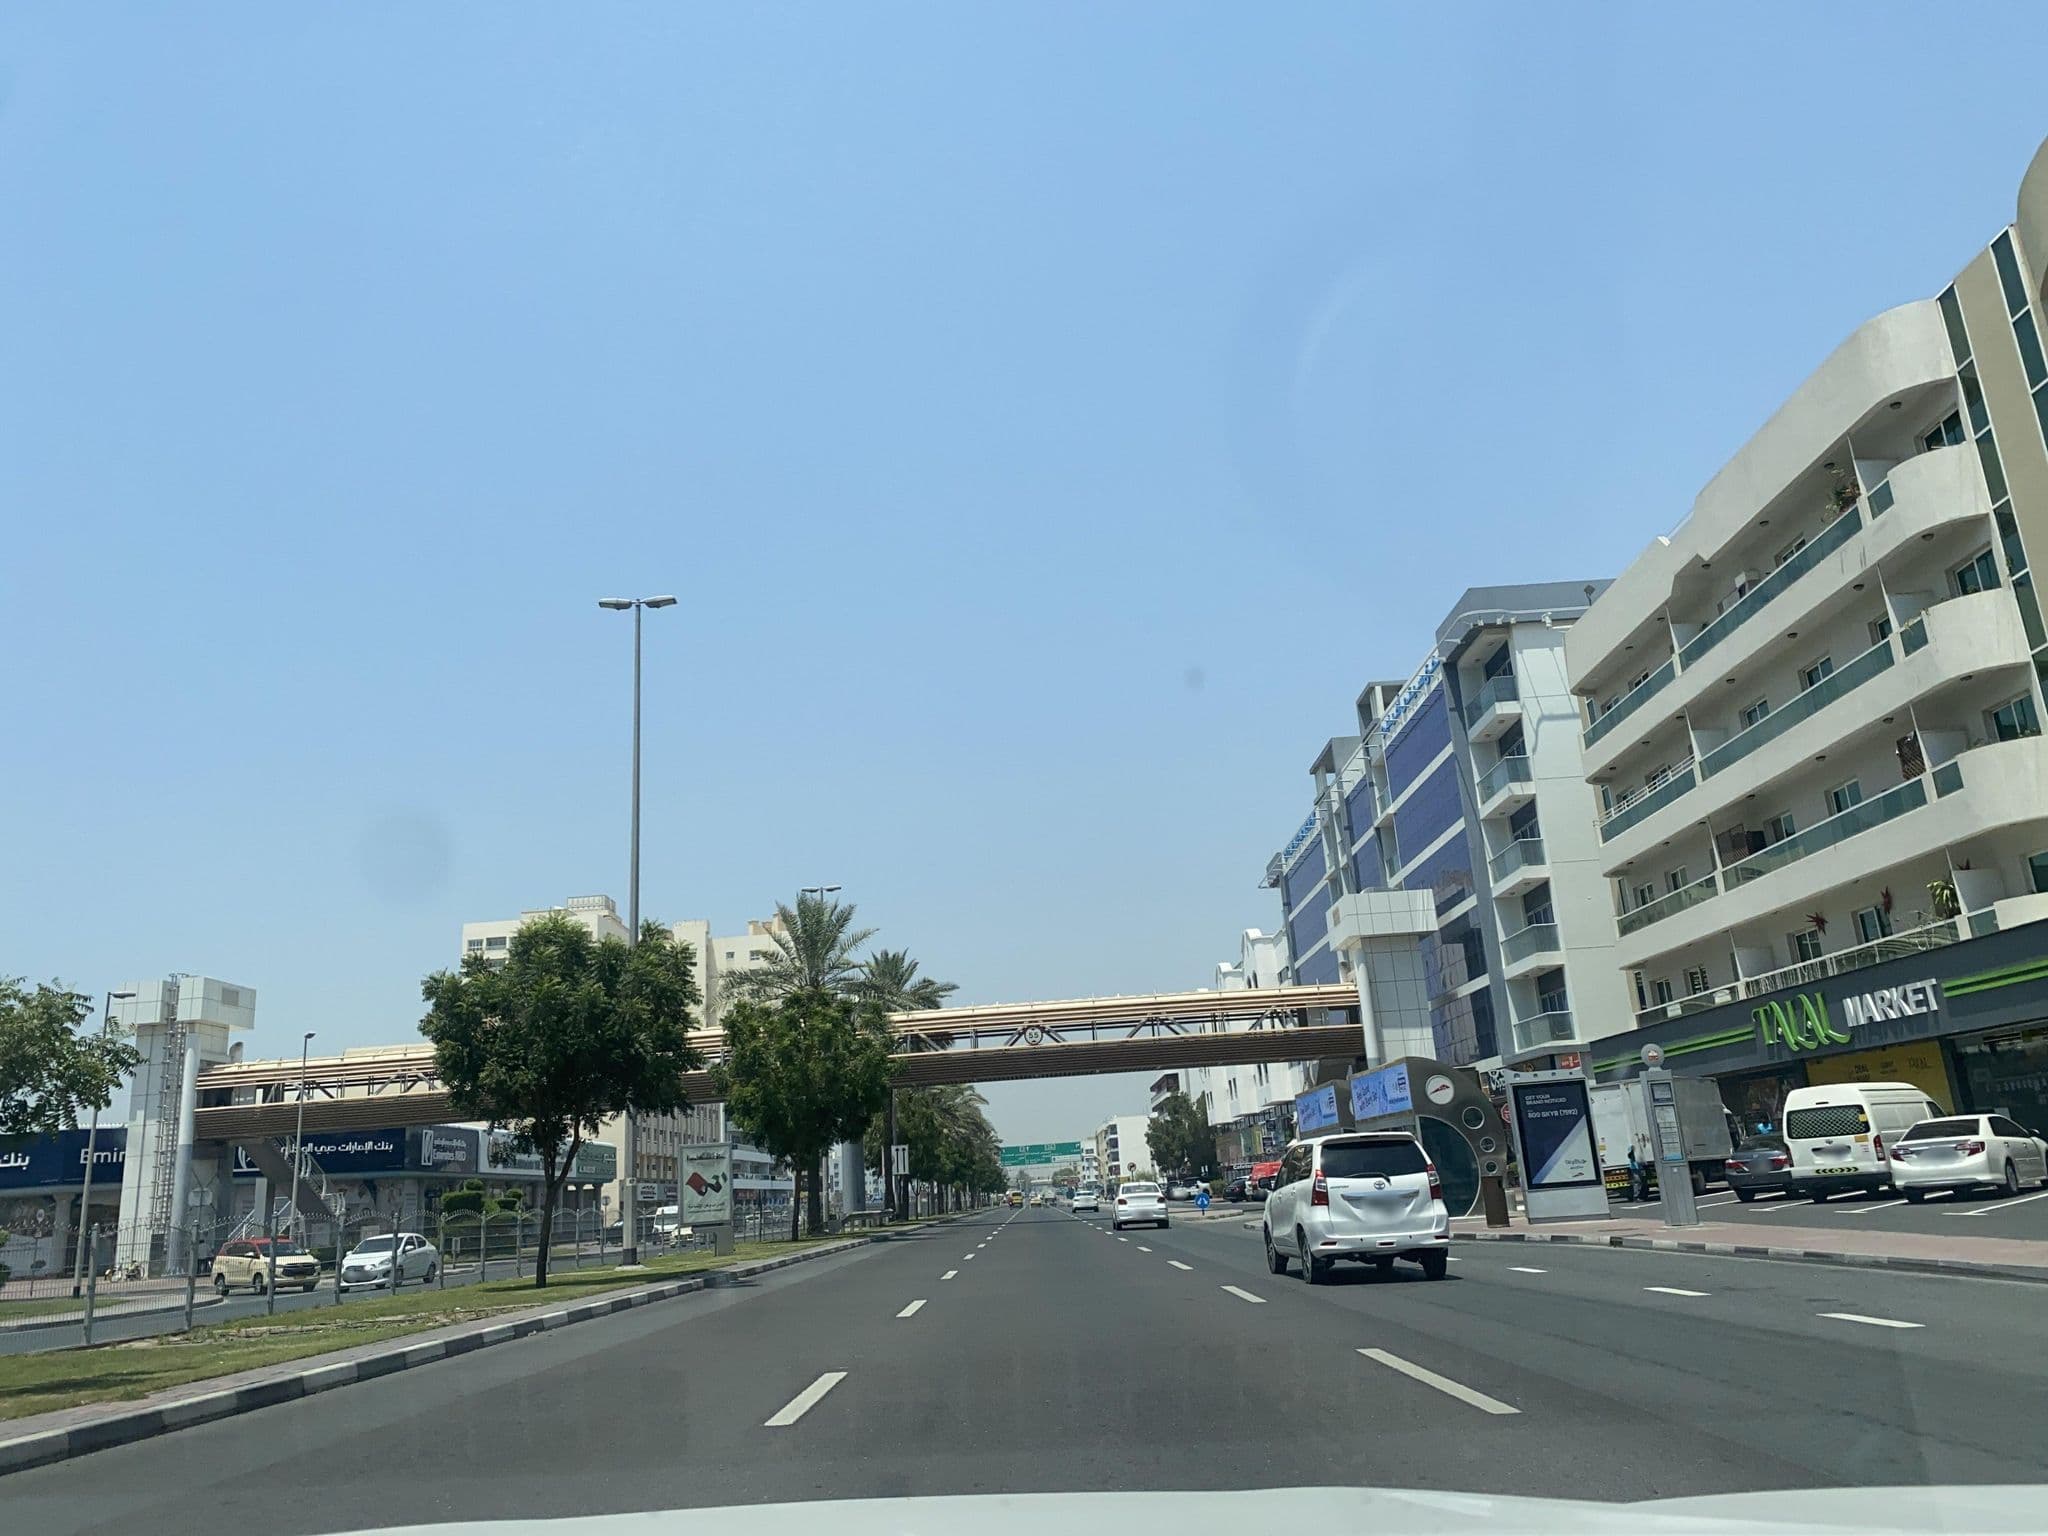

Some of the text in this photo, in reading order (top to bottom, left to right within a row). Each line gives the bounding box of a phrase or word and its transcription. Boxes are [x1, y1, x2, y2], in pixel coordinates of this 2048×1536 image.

[1752, 978, 1939, 1051] TALAL MARKET
[338, 1141, 373, 1155] الإمارات
[374, 1141, 394, 1153] بنك
